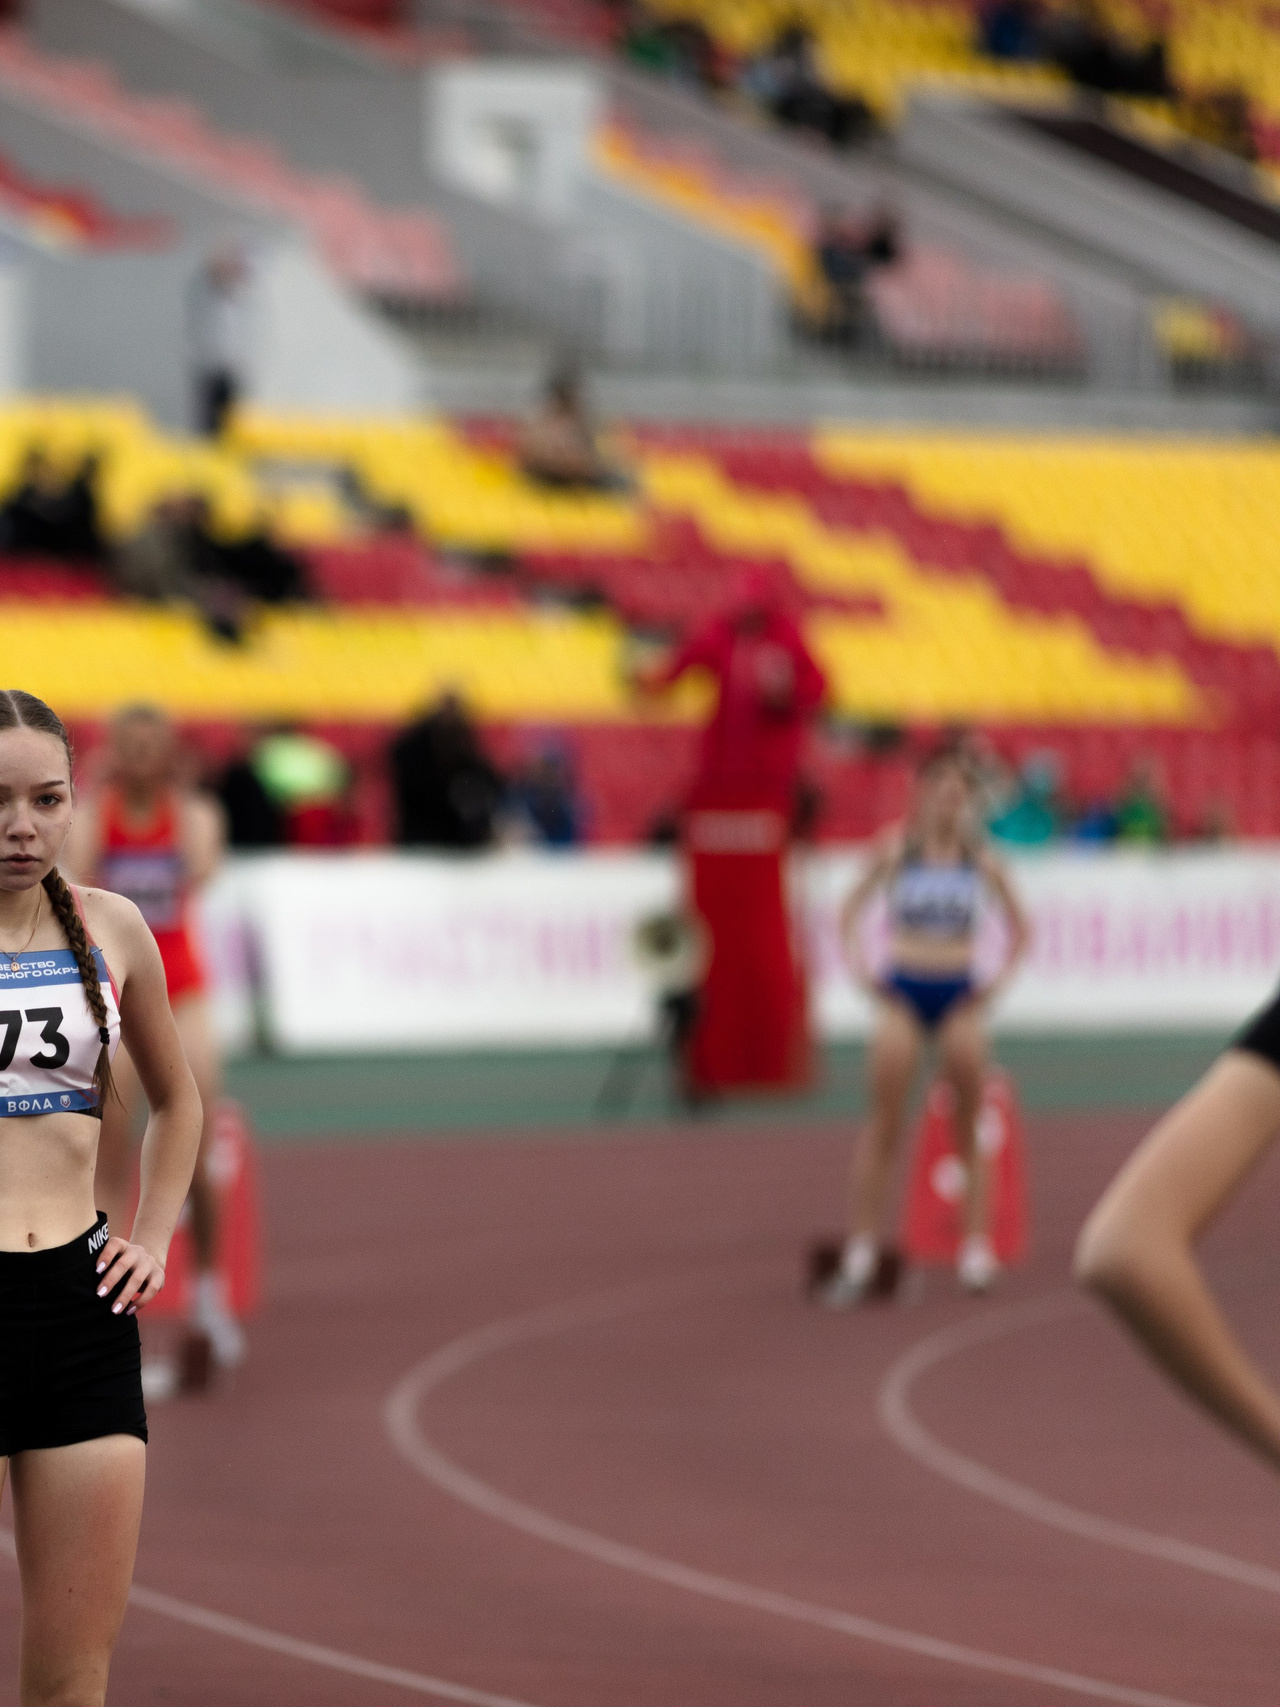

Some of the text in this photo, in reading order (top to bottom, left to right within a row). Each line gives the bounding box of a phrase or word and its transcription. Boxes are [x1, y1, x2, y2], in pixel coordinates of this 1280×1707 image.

[43, 966, 80, 976] ОКРУ
[7, 1098, 53, 1113] ВФЛА
[87, 1222, 109, 1255] NIKE
